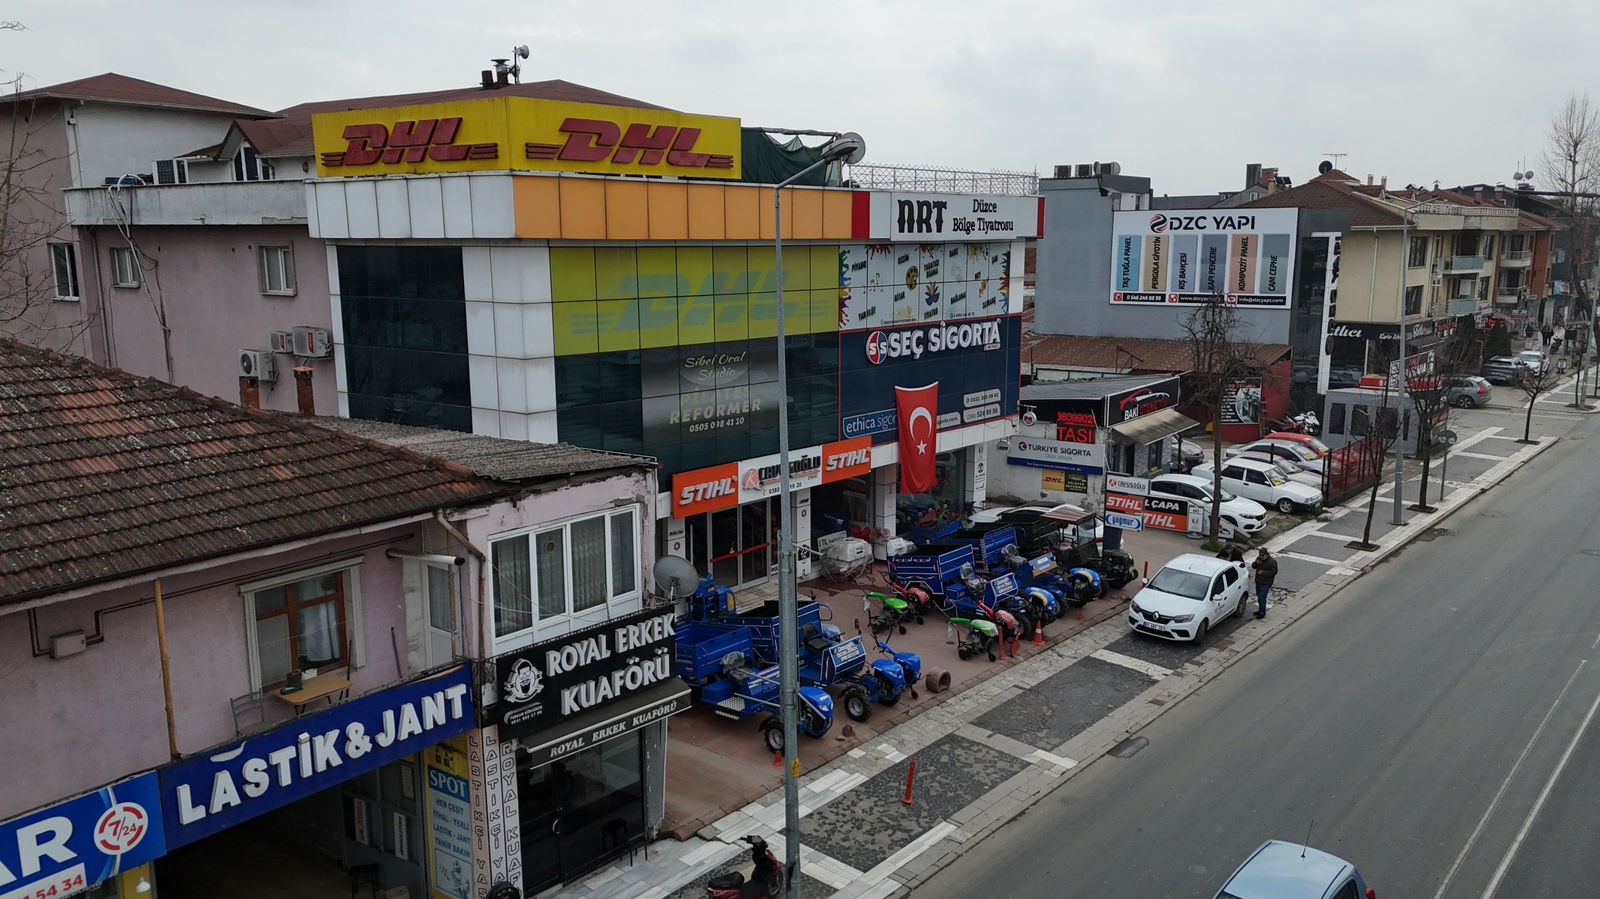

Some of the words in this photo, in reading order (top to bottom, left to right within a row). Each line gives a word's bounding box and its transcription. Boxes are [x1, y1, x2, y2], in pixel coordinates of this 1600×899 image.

[342, 117, 471, 167] DHL
[559, 118, 709, 168] DHL
[973, 199, 997, 213] Düzce
[953, 217, 975, 234] Bölge
[977, 218, 1013, 233] Tiyatrosu
[1169, 215, 1207, 230] DZC
[1212, 215, 1255, 230] YAPI
[1124, 236, 1132, 256] PANEL
[1241, 236, 1249, 256] PANEL
[1151, 261, 1160, 289] PERGOLA
[1270, 255, 1278, 276] CEPHE
[1122, 277, 1131, 288] TAŞ
[613, 269, 799, 331] DHL
[888, 329, 924, 359] SEÇ
[928, 320, 1001, 352] SİGORTA
[718, 351, 746, 365] Oral
[697, 366, 736, 381] Studio
[669, 399, 761, 425] REFORMER
[846, 417, 875, 433] ethica
[679, 478, 736, 506] STIHL
[825, 448, 870, 472] STIHL
[1106, 496, 1142, 510] STIHL
[1151, 500, 1180, 511] ÇAPA
[1143, 513, 1176, 528] TIHL
[546, 633, 611, 677] ROYAL
[614, 612, 676, 653] ERKEK
[560, 647, 670, 716] KUAFÖRÜ
[550, 737, 585, 758] ROYAL
[592, 722, 627, 742] ERKEK
[632, 700, 677, 726] KUAFÖRÜ
[429, 767, 467, 799] SPOT
[108, 819, 138, 841] 7/24
[62, 874, 83, 891] 34
